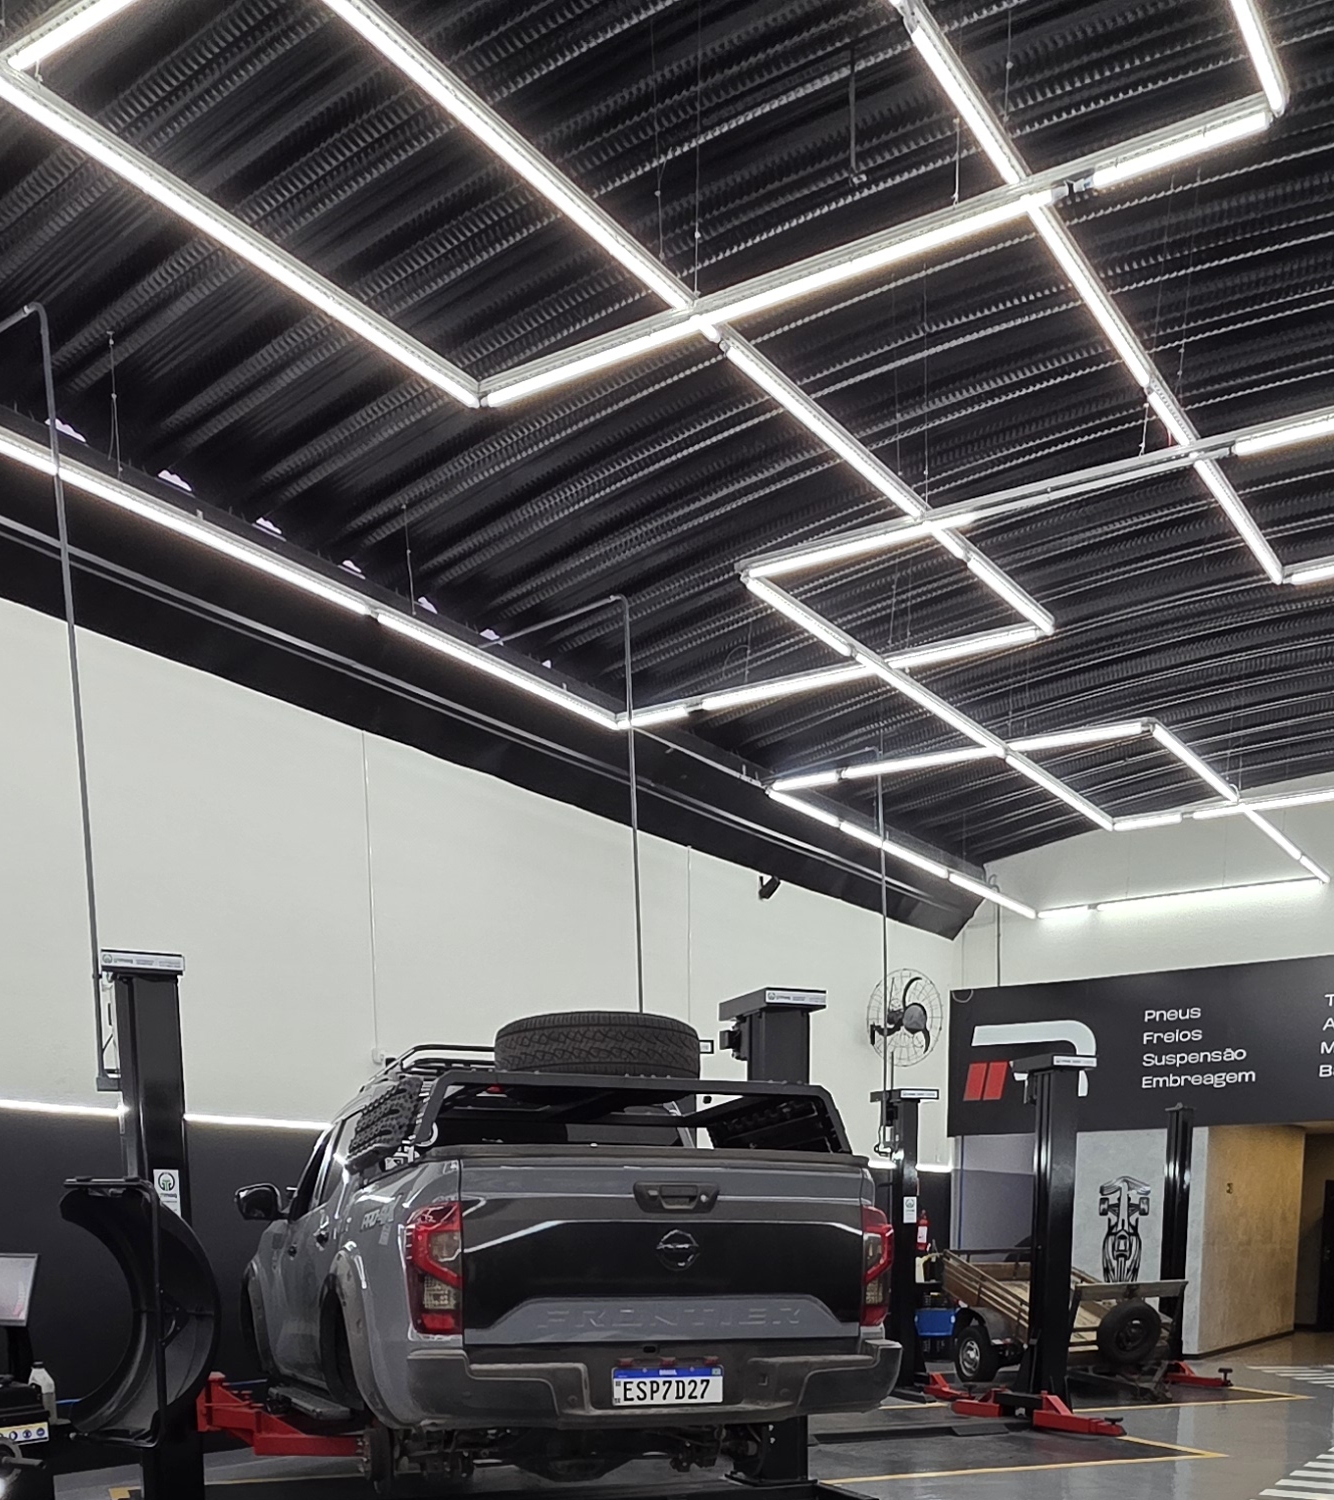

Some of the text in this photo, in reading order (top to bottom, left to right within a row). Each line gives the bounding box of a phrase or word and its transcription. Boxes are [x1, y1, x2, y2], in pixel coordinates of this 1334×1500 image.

[1143, 1007, 1202, 1023] Pneus
[1142, 1028, 1203, 1045] Freios
[1141, 1047, 1247, 1068] Suspensão
[1141, 1070, 1256, 1089] Embreagem
[536, 1307, 801, 1328] FRONTIER
[622, 1378, 711, 1402] ESP7D27
